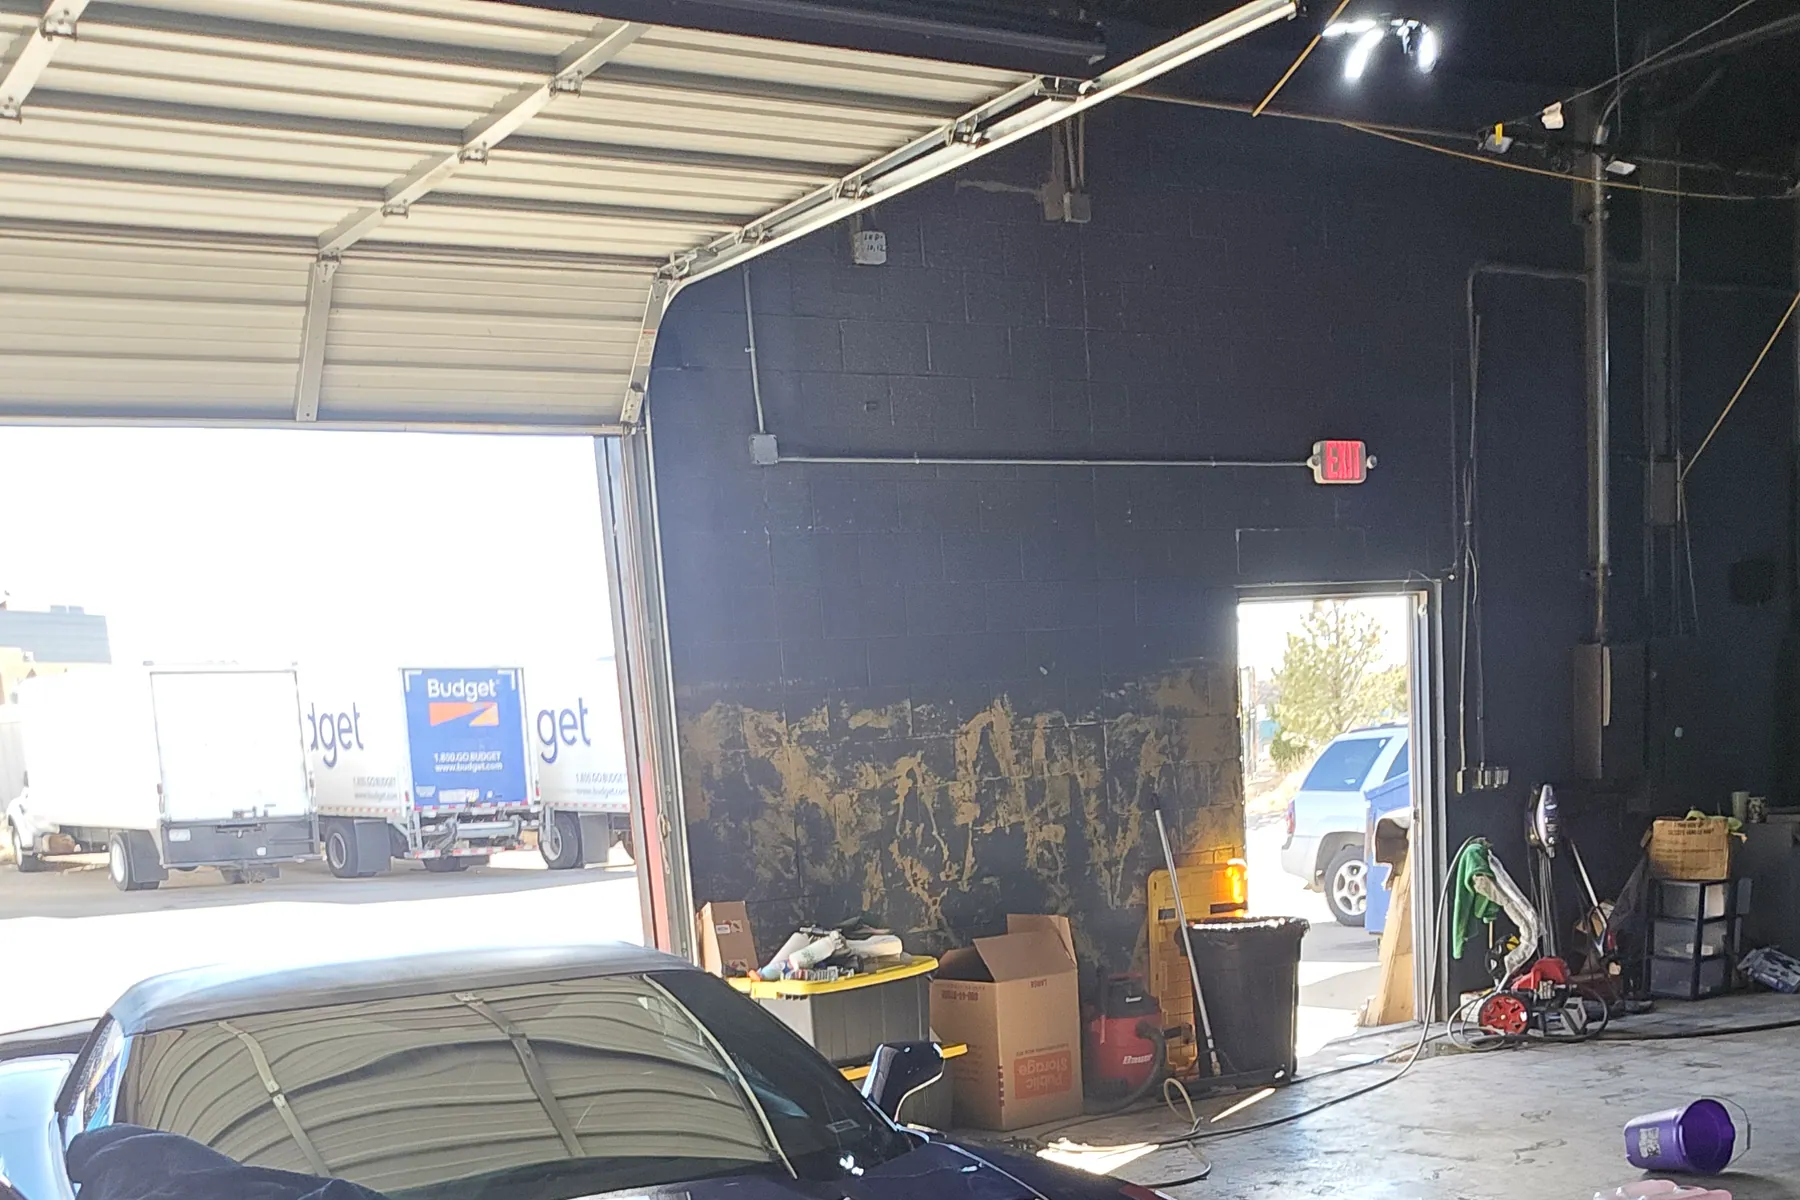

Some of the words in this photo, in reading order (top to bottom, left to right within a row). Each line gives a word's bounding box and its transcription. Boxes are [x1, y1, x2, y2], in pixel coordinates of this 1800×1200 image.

[1326, 441, 1361, 480] EXIT
[427, 679, 497, 703] Budget
[435, 762, 503, 773] www.budget.com
[1018, 1057, 1068, 1076] Storage
[1122, 1053, 1153, 1065] Bauer
[1025, 1072, 1064, 1091] Public
